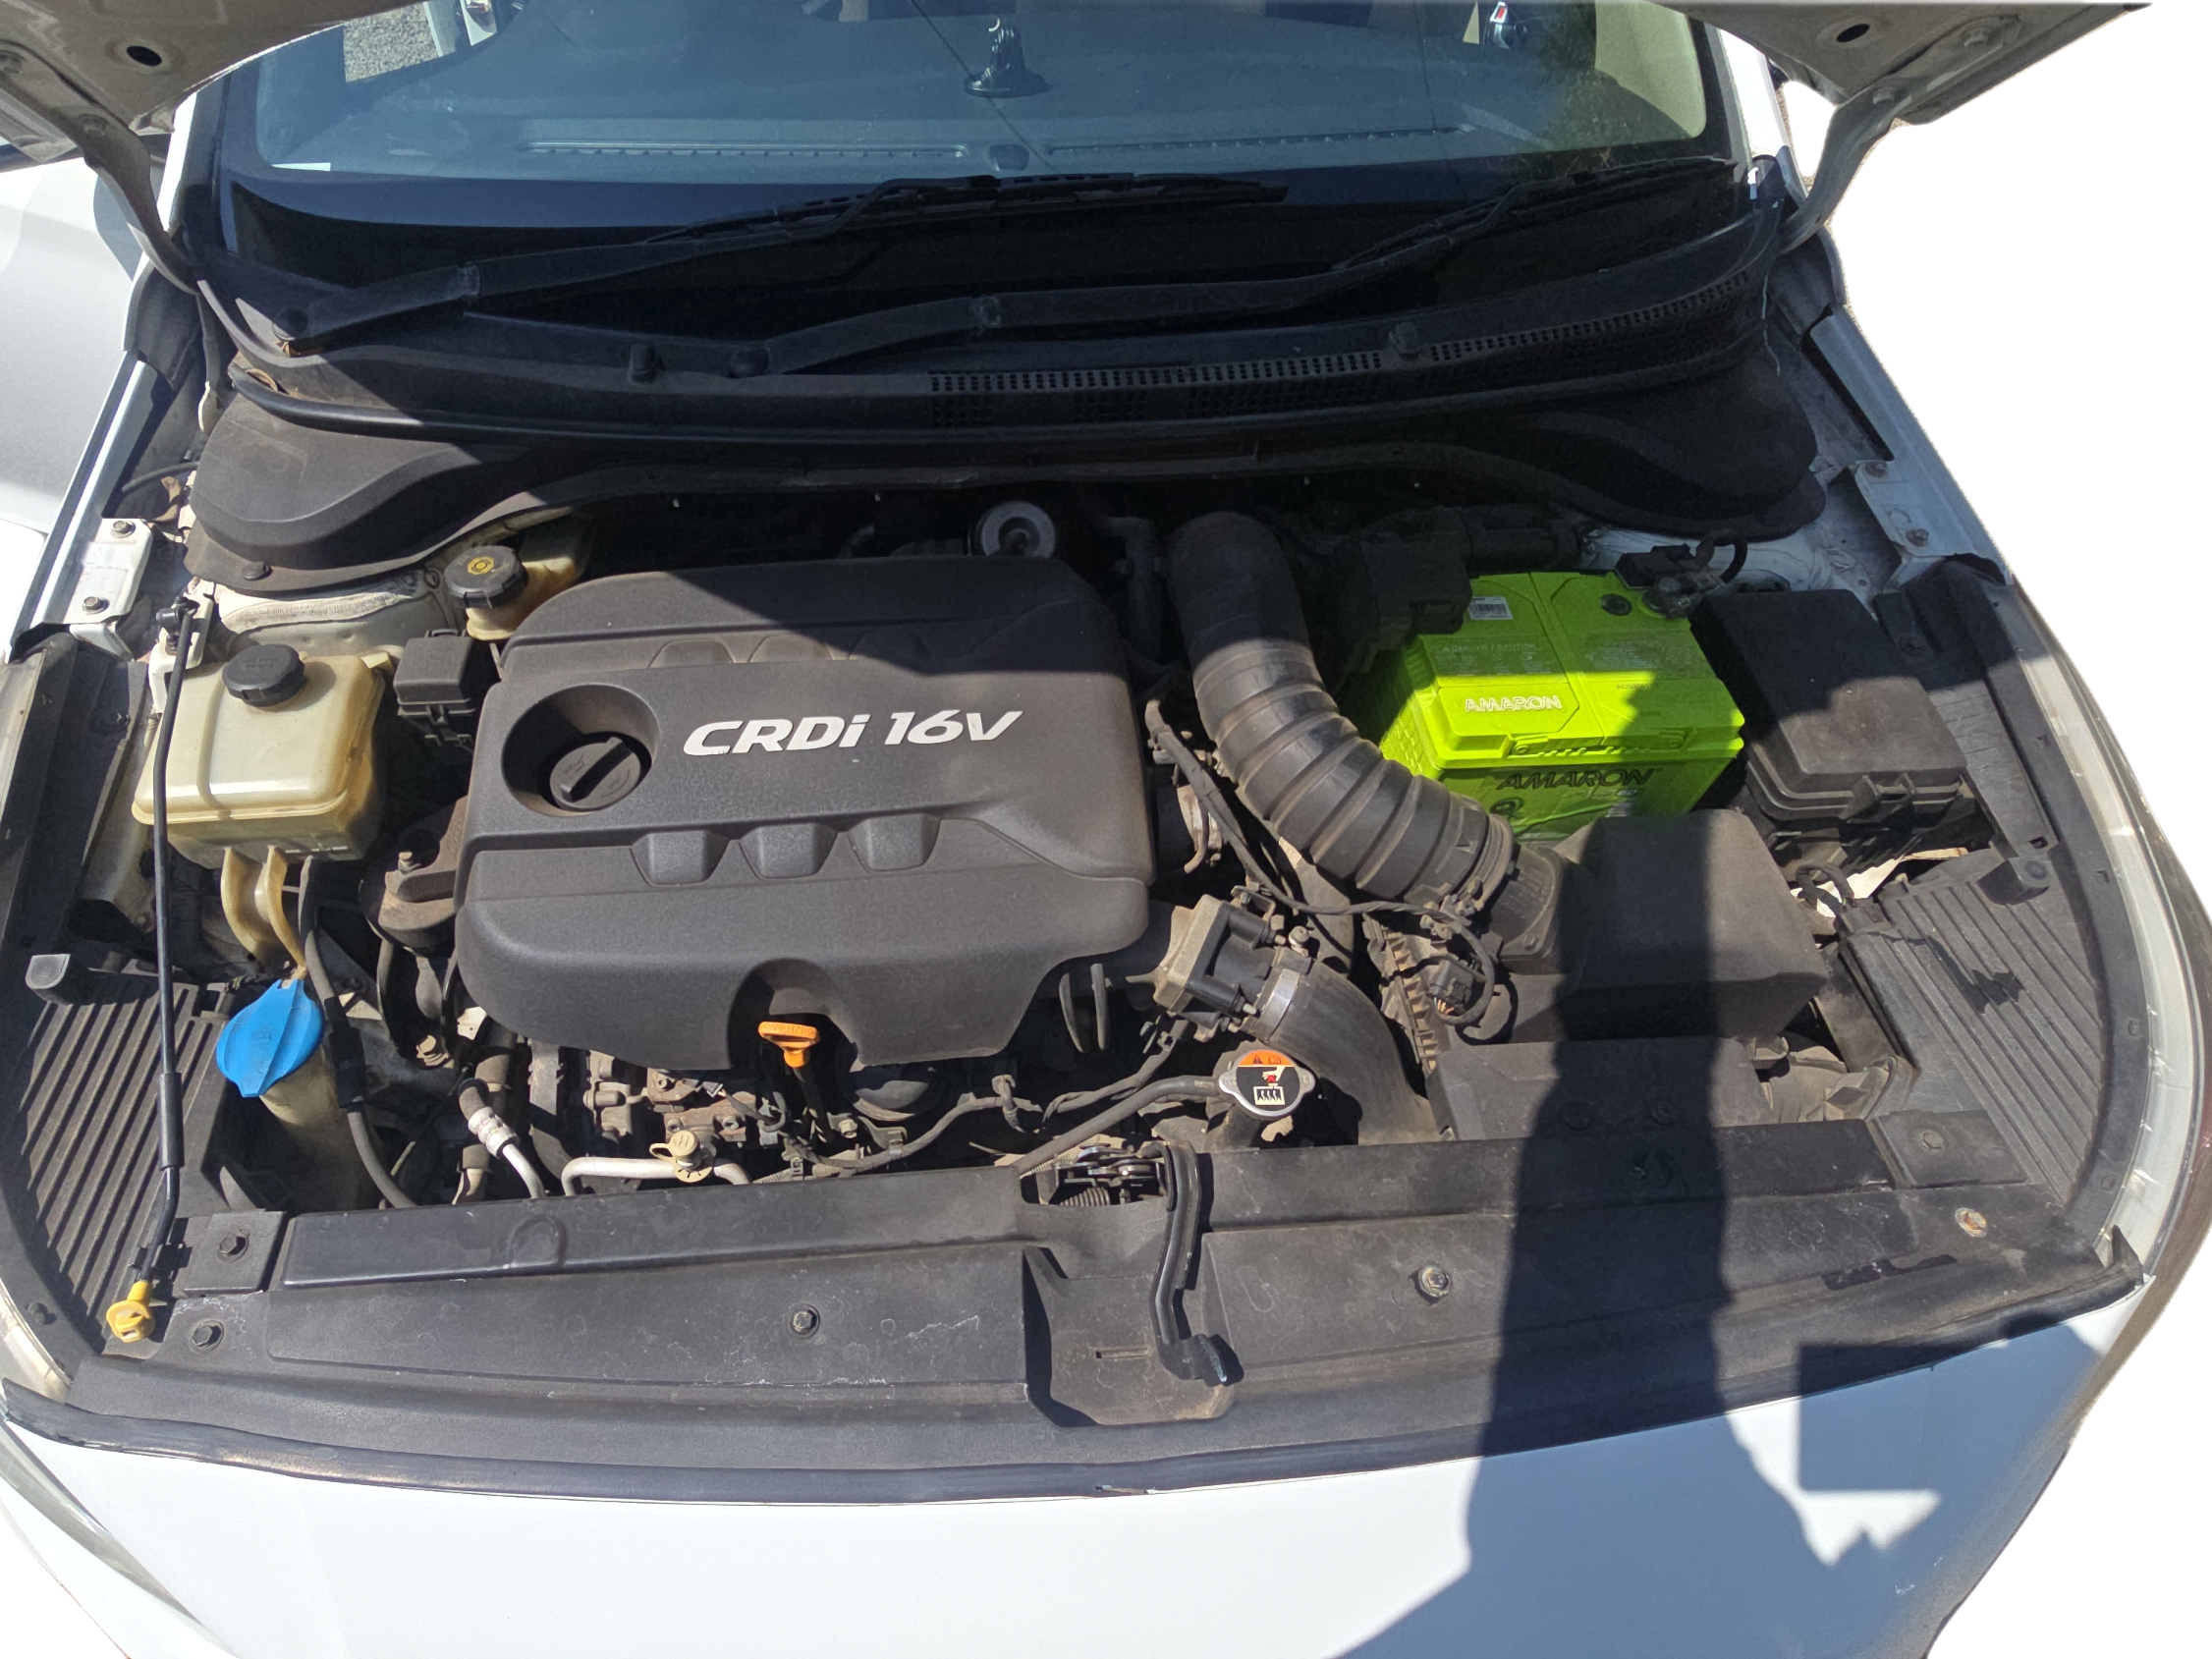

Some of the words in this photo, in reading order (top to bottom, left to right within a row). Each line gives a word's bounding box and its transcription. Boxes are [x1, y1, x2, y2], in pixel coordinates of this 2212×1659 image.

[1465, 695, 1562, 712] AMARON
[683, 713, 870, 756] CRDi
[884, 709, 1023, 745] 16V
[1497, 768, 1654, 790] AMARON
